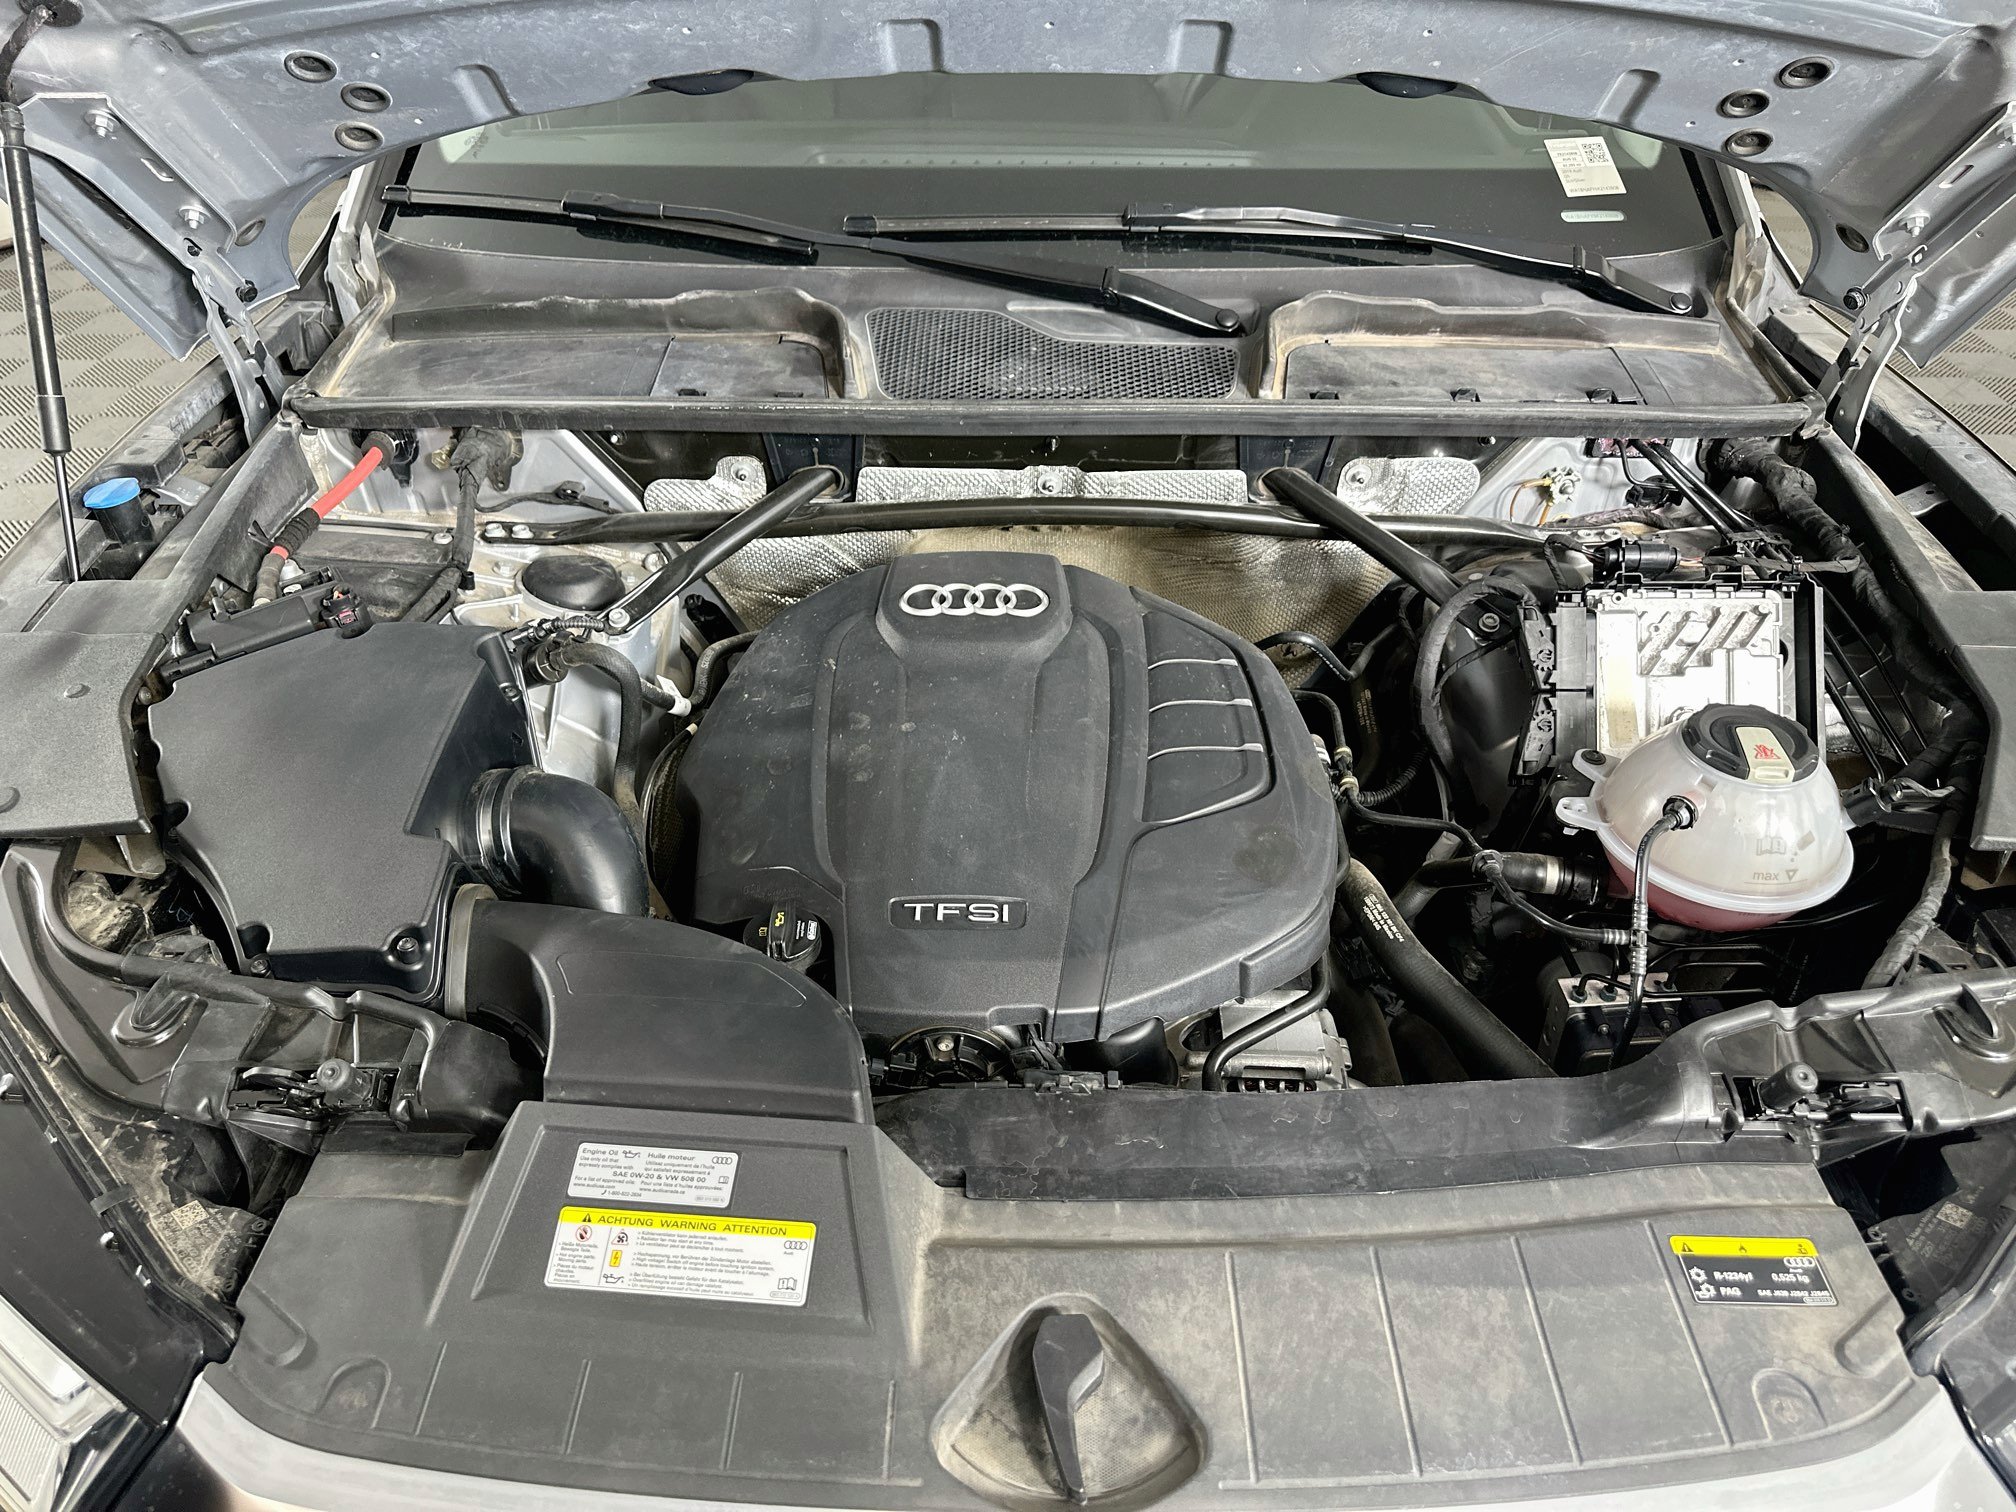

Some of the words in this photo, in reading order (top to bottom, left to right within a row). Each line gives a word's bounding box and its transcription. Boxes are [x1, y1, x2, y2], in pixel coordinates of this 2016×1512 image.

[1752, 871, 1780, 882] max
[903, 903, 1010, 922] TFSI
[582, 1147, 606, 1155] Engine
[629, 1171, 654, 1179] 0W-20
[597, 1215, 654, 1226] ACHTUNG
[659, 1219, 717, 1230] WARNING
[722, 1223, 787, 1235] ATTENTION
[1713, 1271, 1754, 1282] R-1234yf
[1771, 1273, 1796, 1281] 0,525
[1797, 1273, 1809, 1283] kg
[1720, 1287, 1741, 1295] PAG
